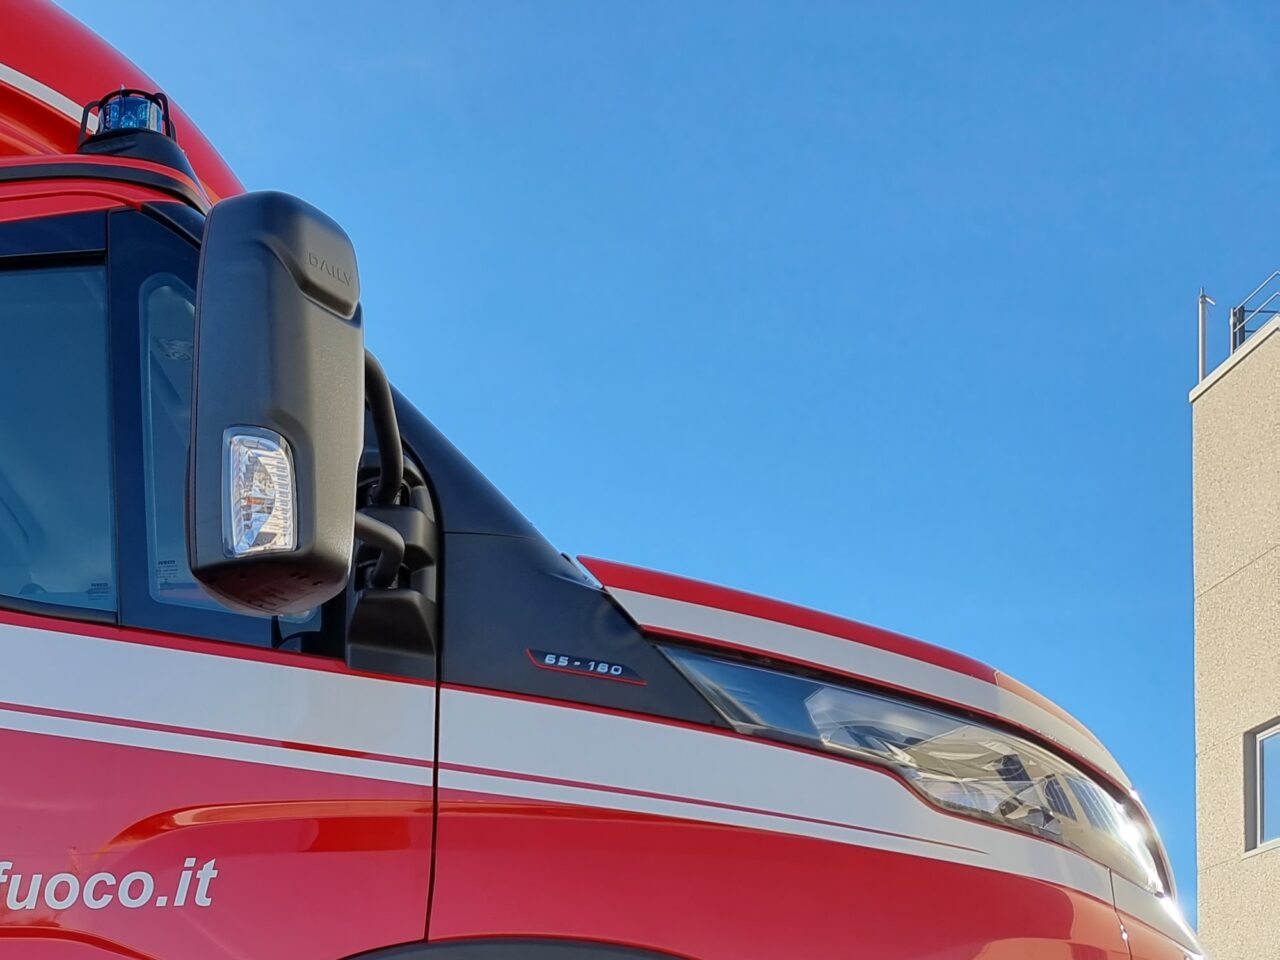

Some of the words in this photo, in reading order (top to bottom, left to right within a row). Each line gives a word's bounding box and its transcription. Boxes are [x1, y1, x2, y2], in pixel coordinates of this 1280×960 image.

[307, 252, 352, 287] DAILY
[544, 654, 569, 666] 65
[588, 661, 623, 676] 180
